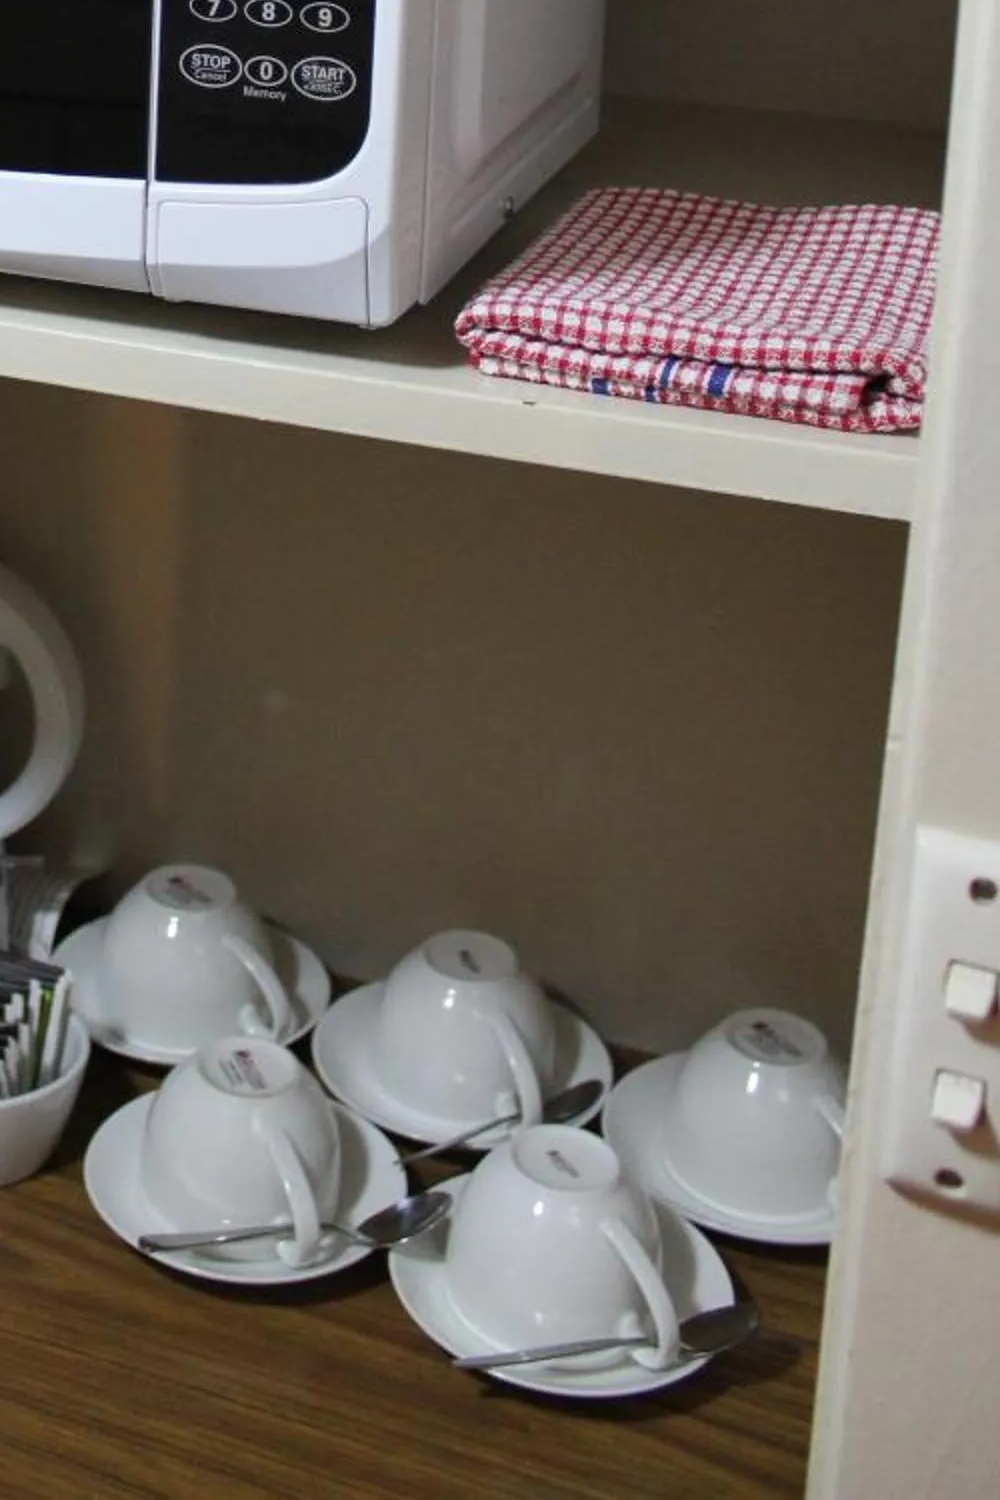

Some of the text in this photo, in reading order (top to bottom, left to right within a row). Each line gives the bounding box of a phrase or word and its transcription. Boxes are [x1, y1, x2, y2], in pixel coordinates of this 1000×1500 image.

[261, 2, 275, 21] 8
[318, 7, 333, 27] 9
[191, 53, 231, 69] STOP
[301, 64, 345, 81] START
[243, 85, 286, 103] Memory
